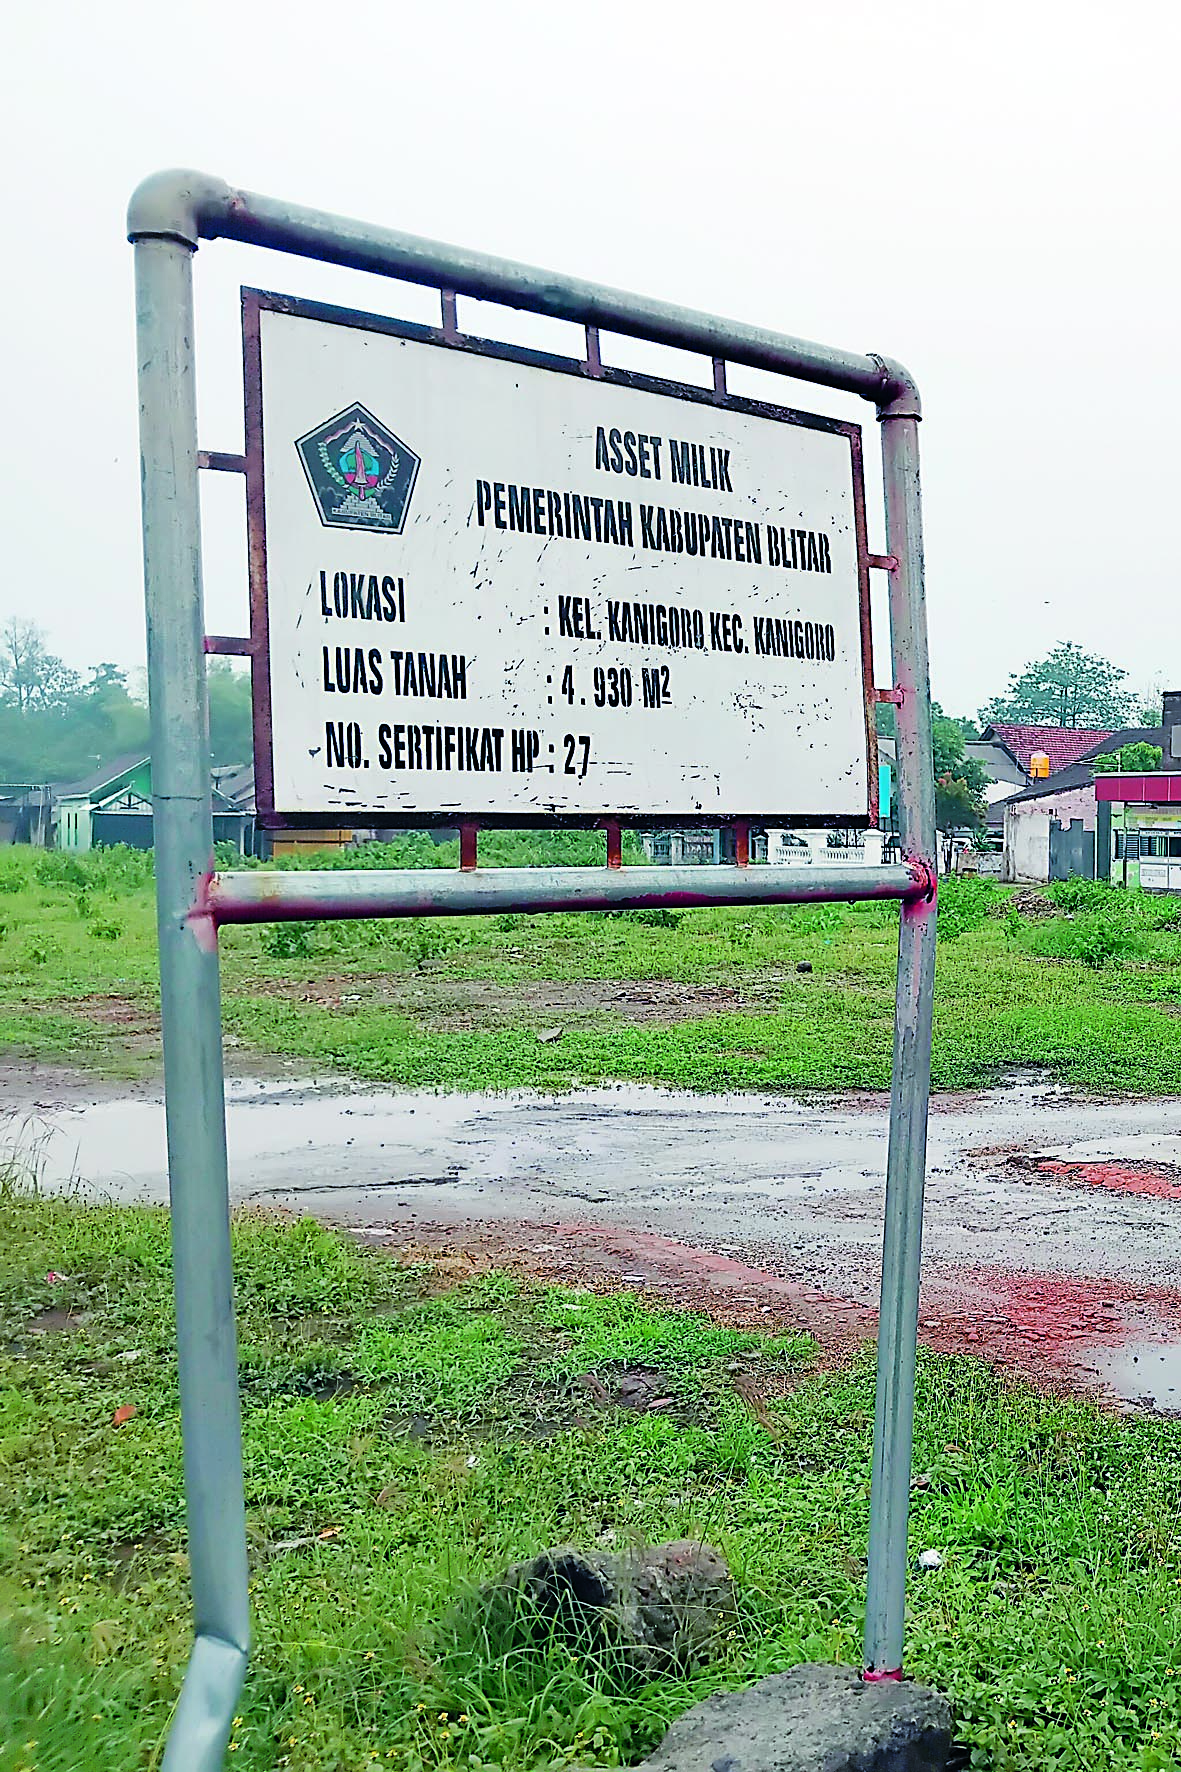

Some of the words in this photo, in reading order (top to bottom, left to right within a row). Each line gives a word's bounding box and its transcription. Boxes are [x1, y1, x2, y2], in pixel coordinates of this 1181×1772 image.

[596, 426, 662, 480] ASSET
[669, 439, 733, 492] MILIK
[476, 479, 634, 547] PEMERINTAH
[639, 504, 762, 564] KABUPATEN
[767, 525, 831, 573] BLITAR
[320, 570, 405, 622] LOKASI
[558, 595, 601, 640] KEL.
[607, 600, 704, 650] KANIGORO
[710, 611, 749, 653] KEC.
[753, 616, 835, 662] KANIGORO
[322, 646, 383, 695] LUAS
[390, 650, 467, 699] TANAH
[326, 721, 369, 768] NO.
[378, 724, 504, 772] SERTIFIKAT
[511, 729, 540, 773] HP
[563, 734, 590, 776] 27
